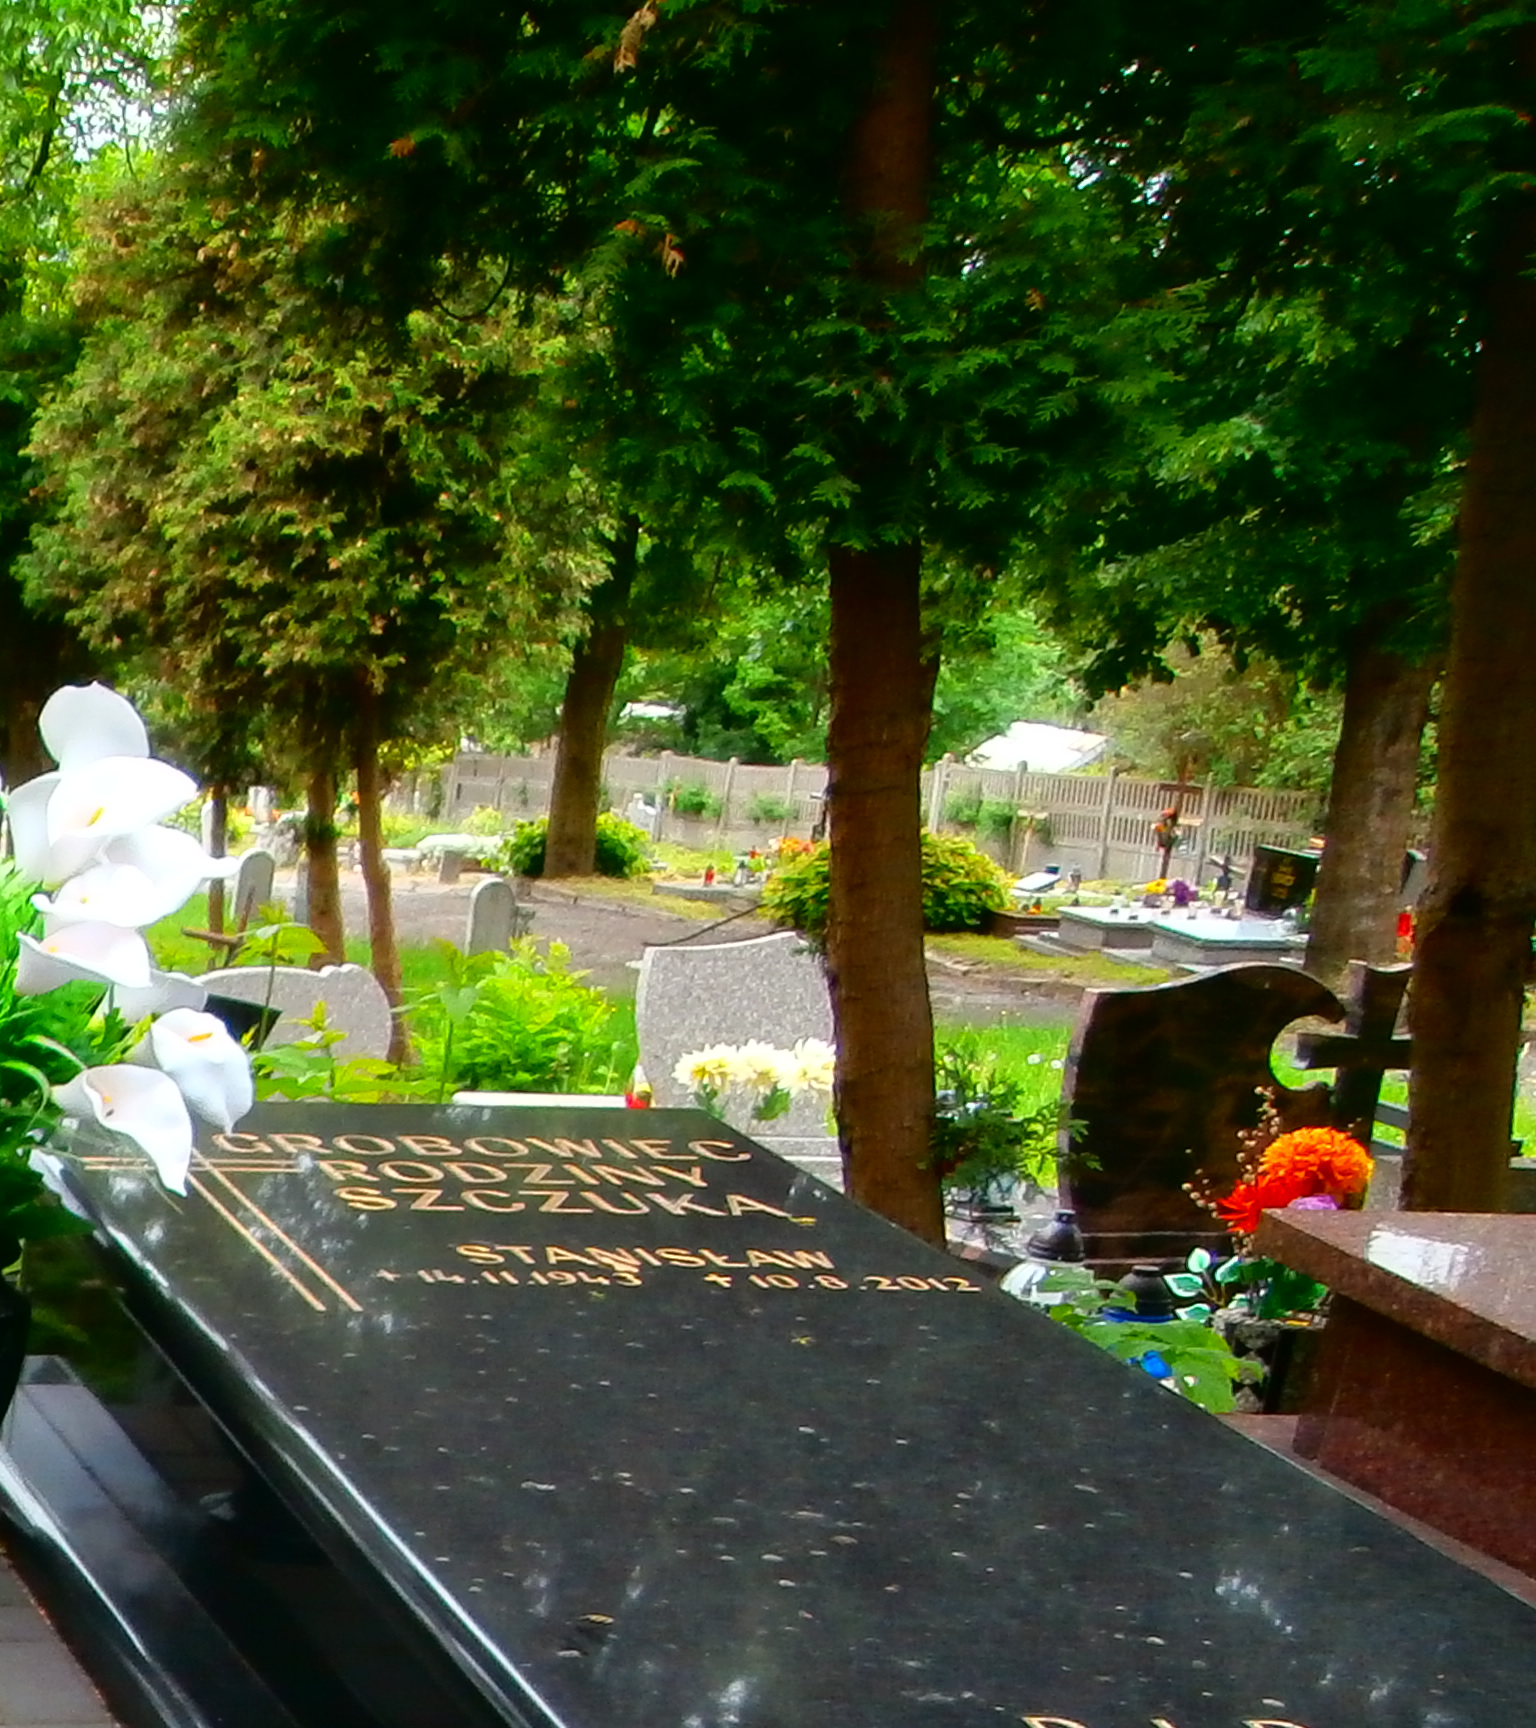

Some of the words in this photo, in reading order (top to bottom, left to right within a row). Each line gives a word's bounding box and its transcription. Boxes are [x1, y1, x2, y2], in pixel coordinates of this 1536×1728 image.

[211, 1131, 753, 1163] GROBOWIEC
[314, 1158, 709, 1189] RODZINY
[332, 1185, 794, 1221] SZCZUKA
[454, 1243, 836, 1271] STANISŁAW
